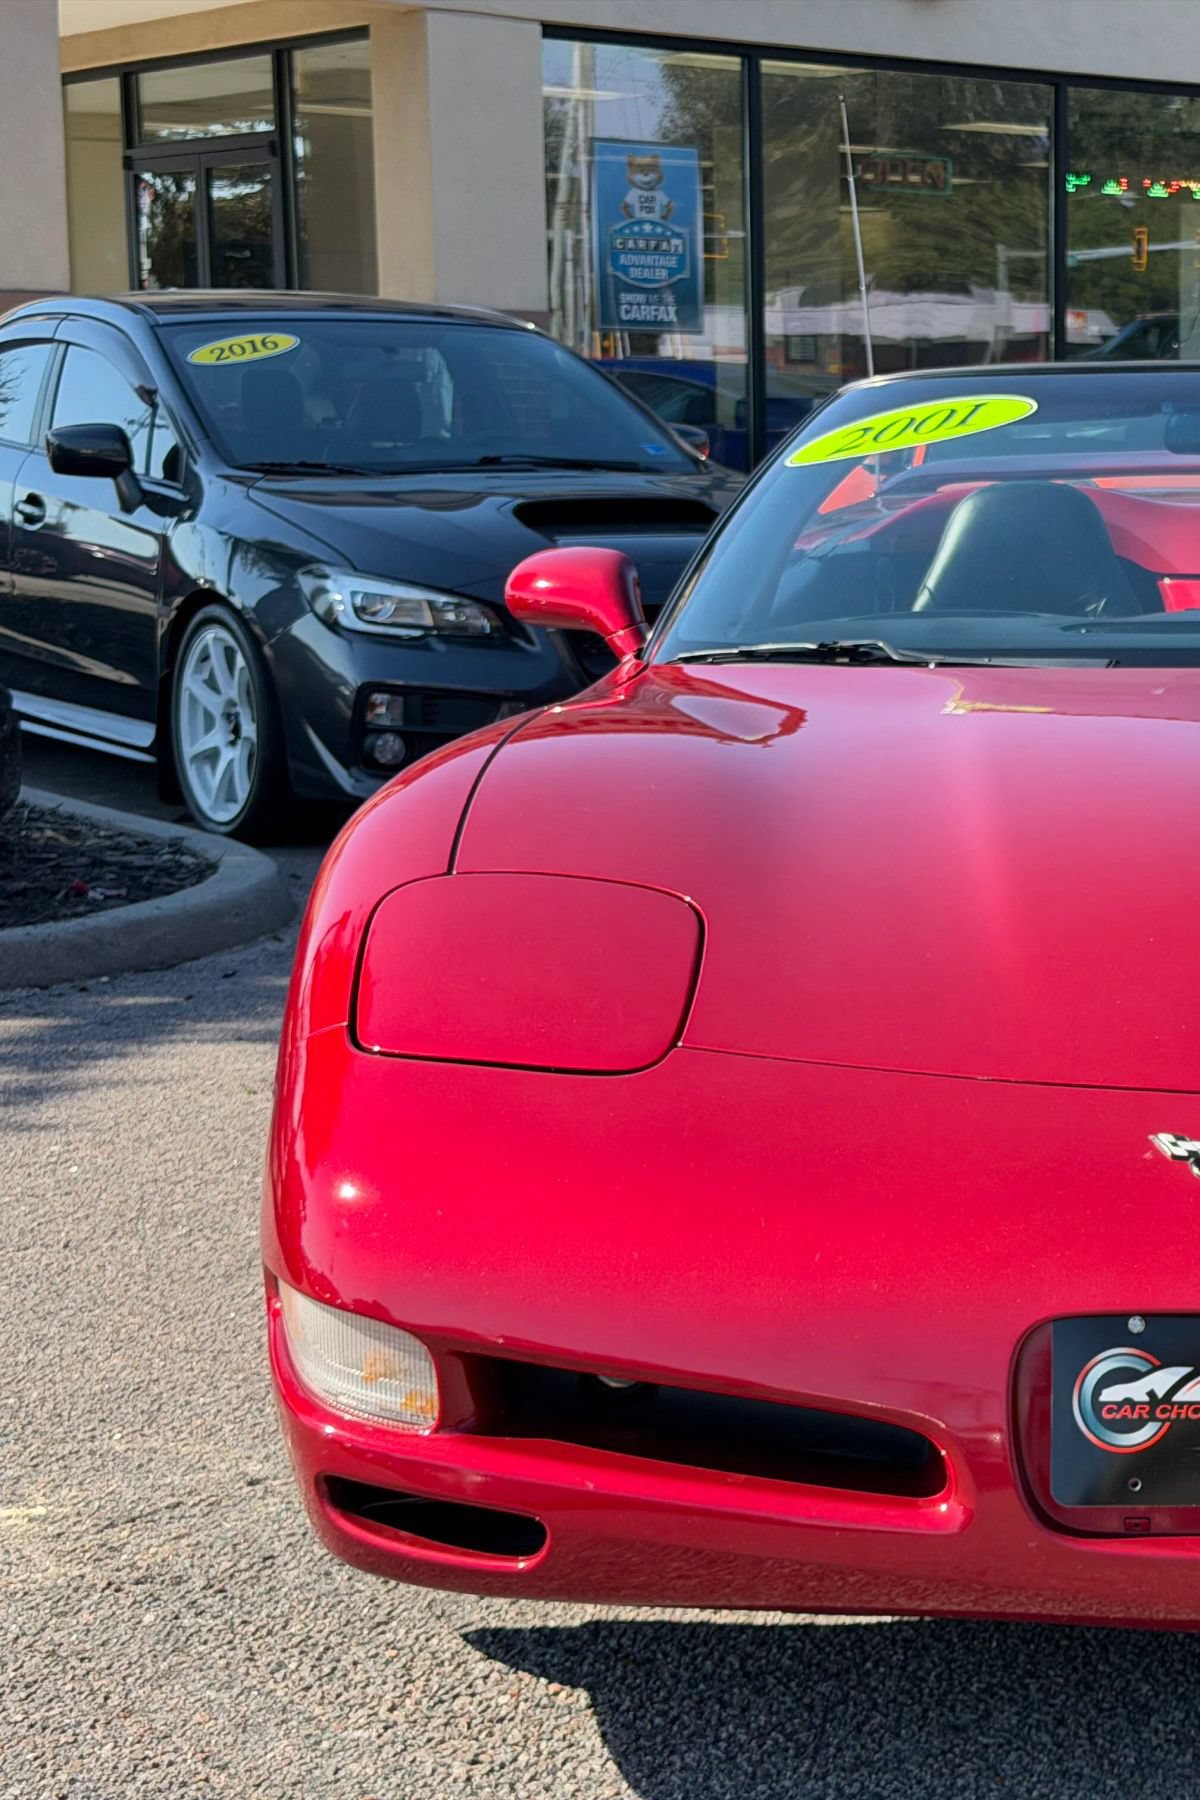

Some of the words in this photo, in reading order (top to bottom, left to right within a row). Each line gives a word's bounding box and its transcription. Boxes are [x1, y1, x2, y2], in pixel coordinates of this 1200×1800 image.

[638, 195, 657, 205] CAR
[639, 206, 656, 214] FOX
[615, 238, 683, 253] CARFAX
[620, 254, 679, 268] ADVANTAGE
[629, 267, 669, 280] DEALER
[619, 293, 647, 304] SHOW
[620, 304, 678, 322] CARFAX
[209, 335, 279, 362] 2016
[825, 401, 990, 458] 2001
[1101, 1404, 1150, 1420] CAR
